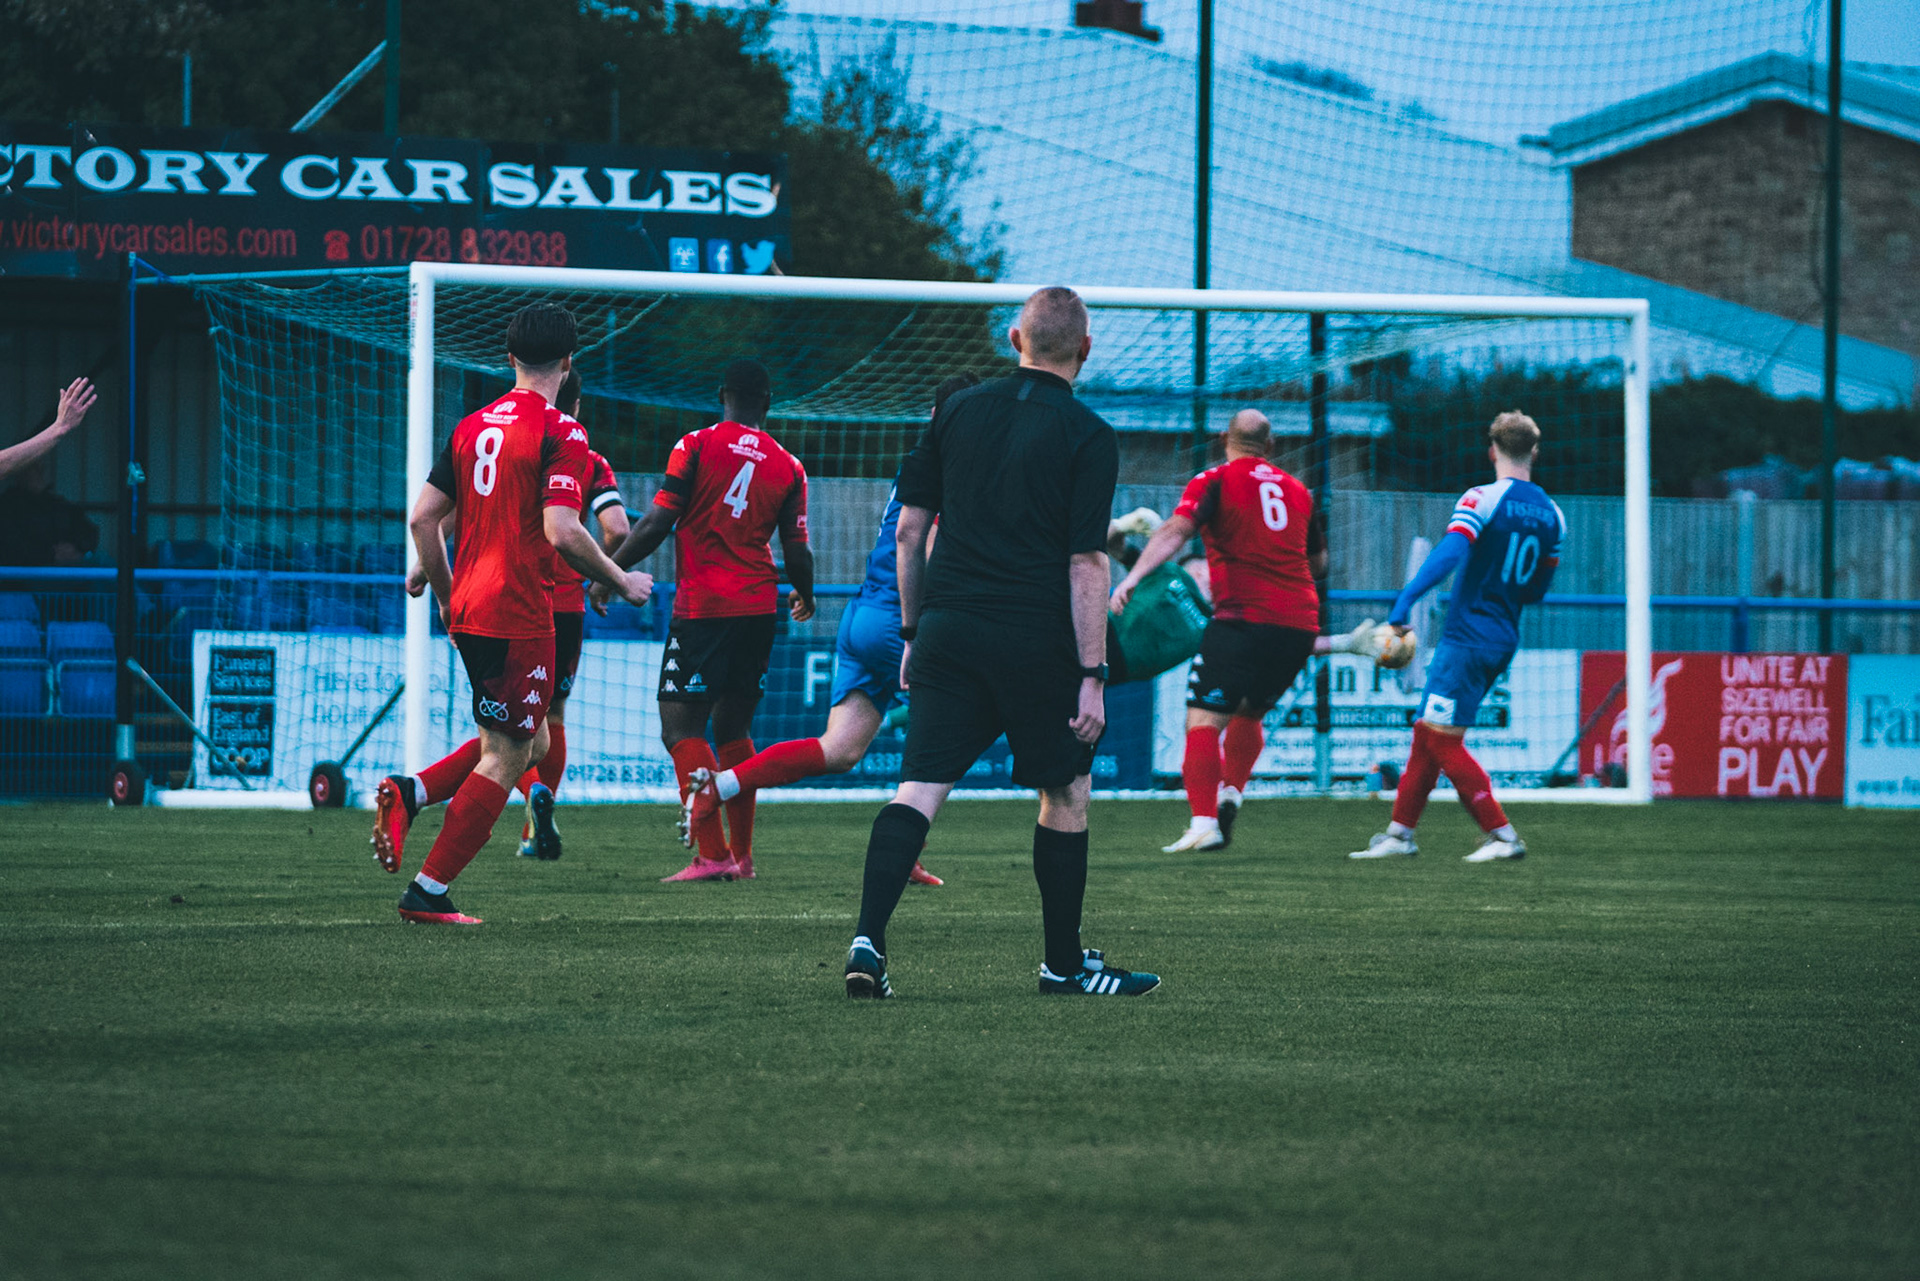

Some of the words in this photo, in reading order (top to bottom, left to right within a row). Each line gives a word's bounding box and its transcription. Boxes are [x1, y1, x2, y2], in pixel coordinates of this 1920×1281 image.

[0, 143, 270, 197] TORY
[280, 153, 473, 205] CAR
[487, 161, 778, 219] SALES
[0, 215, 297, 259] .victorycarsales.com
[361, 224, 451, 262] 01728
[461, 227, 568, 267] 832938
[473, 426, 505, 497] 8
[723, 460, 756, 519] 4
[1258, 481, 1289, 532] 6
[1501, 531, 1540, 585] 10
[1720, 655, 1796, 686] UNITE
[1799, 655, 1832, 685] AT
[1721, 686, 1829, 714] SIZEWELL
[1719, 714, 1772, 745] FOR
[1776, 714, 1829, 743] FAIR
[1717, 746, 1829, 797] PLAY
